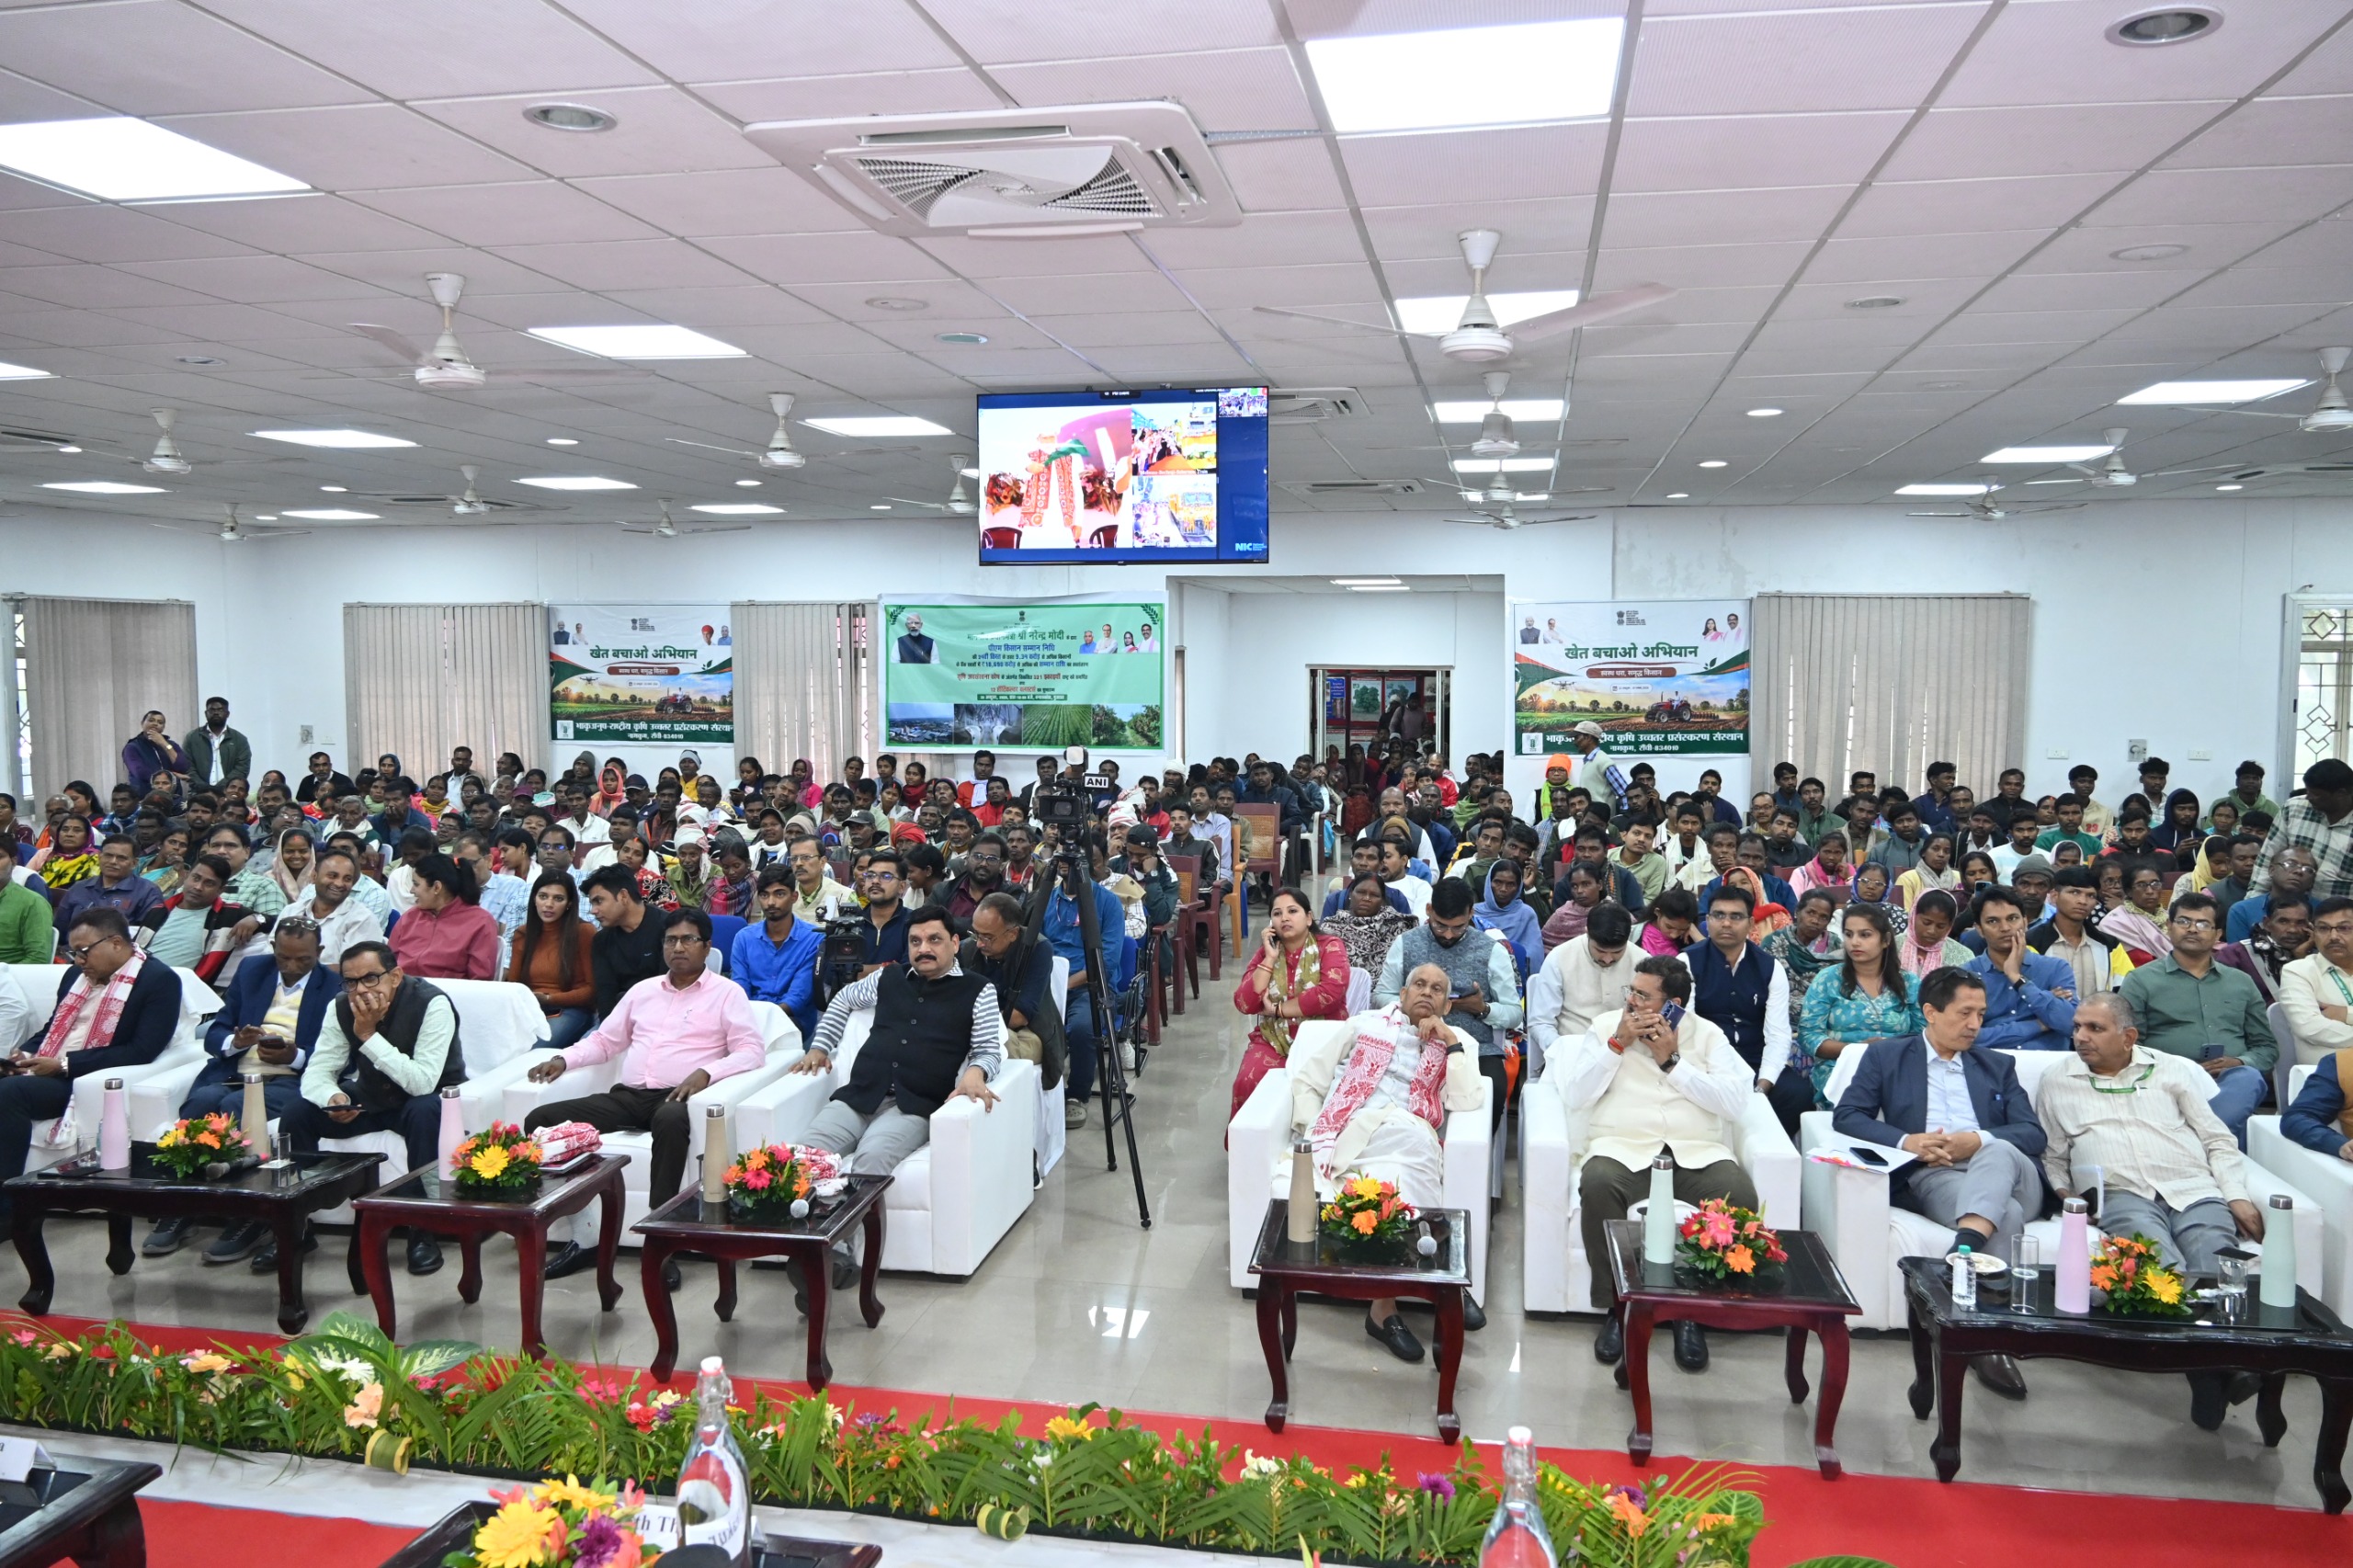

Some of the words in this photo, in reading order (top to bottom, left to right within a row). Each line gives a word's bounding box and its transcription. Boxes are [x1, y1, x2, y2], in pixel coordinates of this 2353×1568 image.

[1235, 543, 1253, 551] NIC
[1048, 630, 1064, 641] मोदी
[589, 645, 609, 659] खेत
[612, 645, 649, 659] बचाओ
[652, 645, 698, 659] अभियान
[1004, 643, 1021, 652] किसान
[1564, 643, 1589, 659] खेत
[1592, 642, 1638, 659] बचाओ
[1642, 642, 1699, 658] अभियान
[633, 721, 648, 732] कृषि
[1617, 732, 1635, 745] कृषि
[1637, 733, 1665, 742] उच्चतर
[1667, 733, 1710, 742] प्रसंस्करण
[1712, 732, 1744, 742] संस्थान
[1086, 778, 1107, 787] ANI
